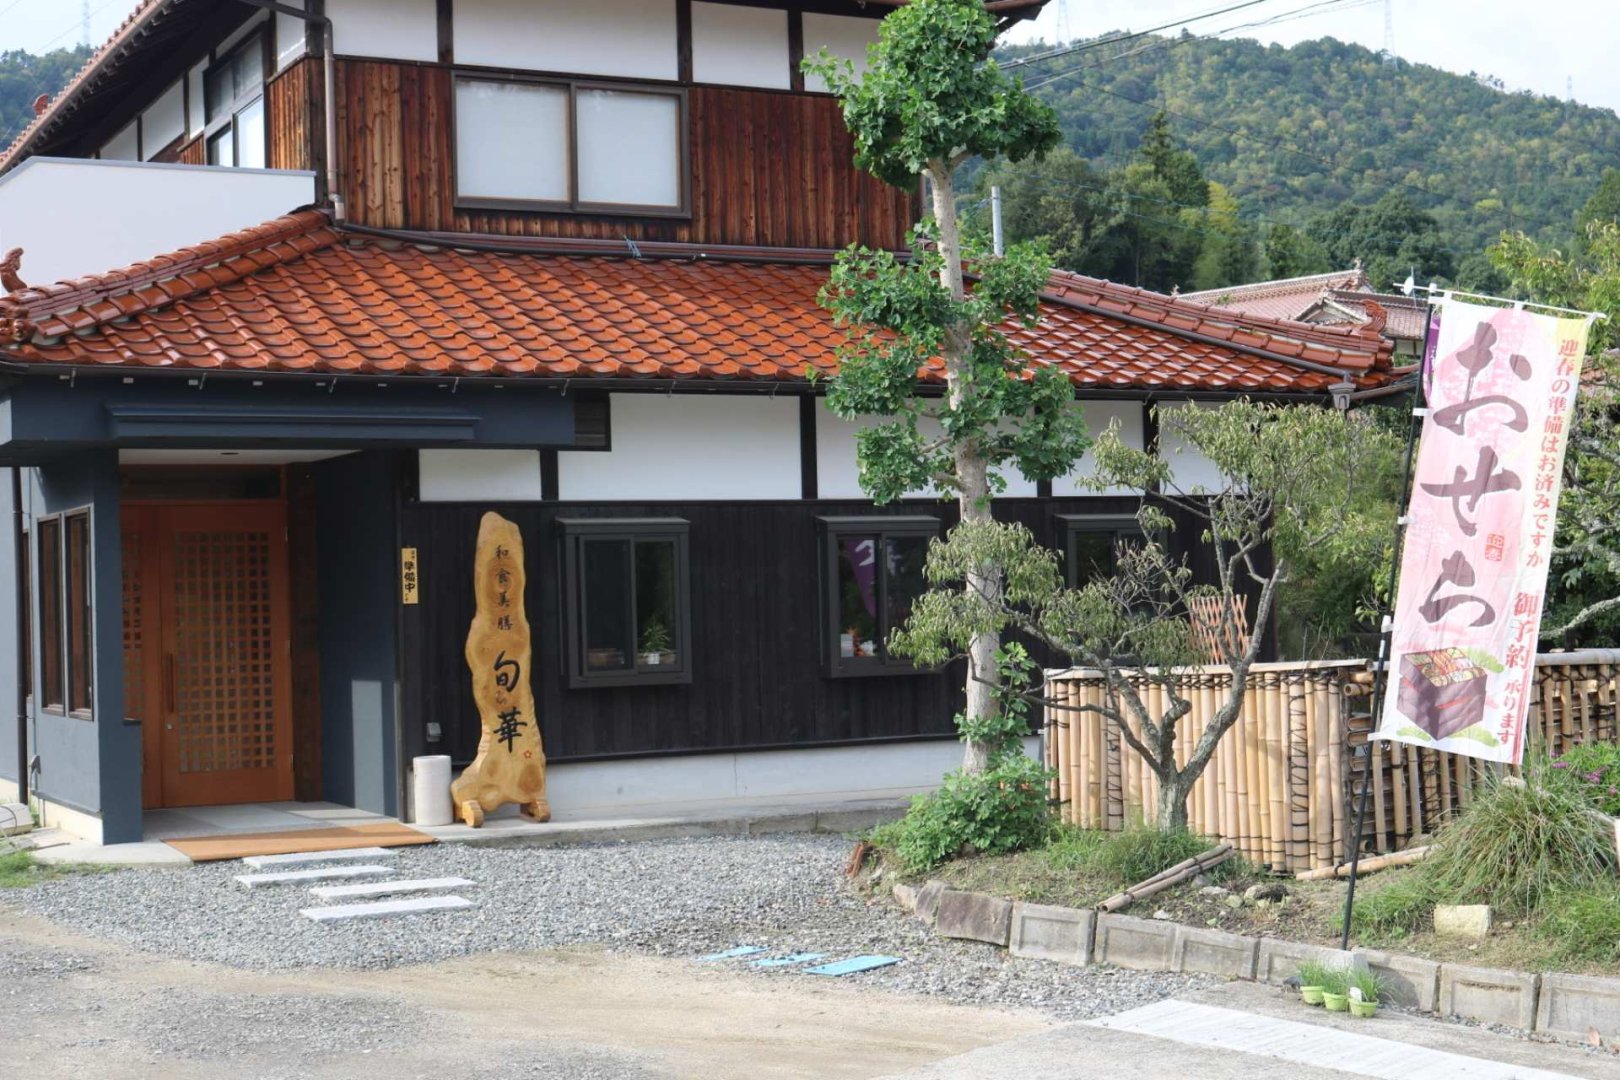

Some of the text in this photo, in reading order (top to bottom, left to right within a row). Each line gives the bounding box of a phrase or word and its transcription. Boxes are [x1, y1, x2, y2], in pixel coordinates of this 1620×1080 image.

[1418, 321, 1532, 627] おせち
[1497, 339, 1579, 745] 迎春の準備はお済みですか 御予約 承ります
